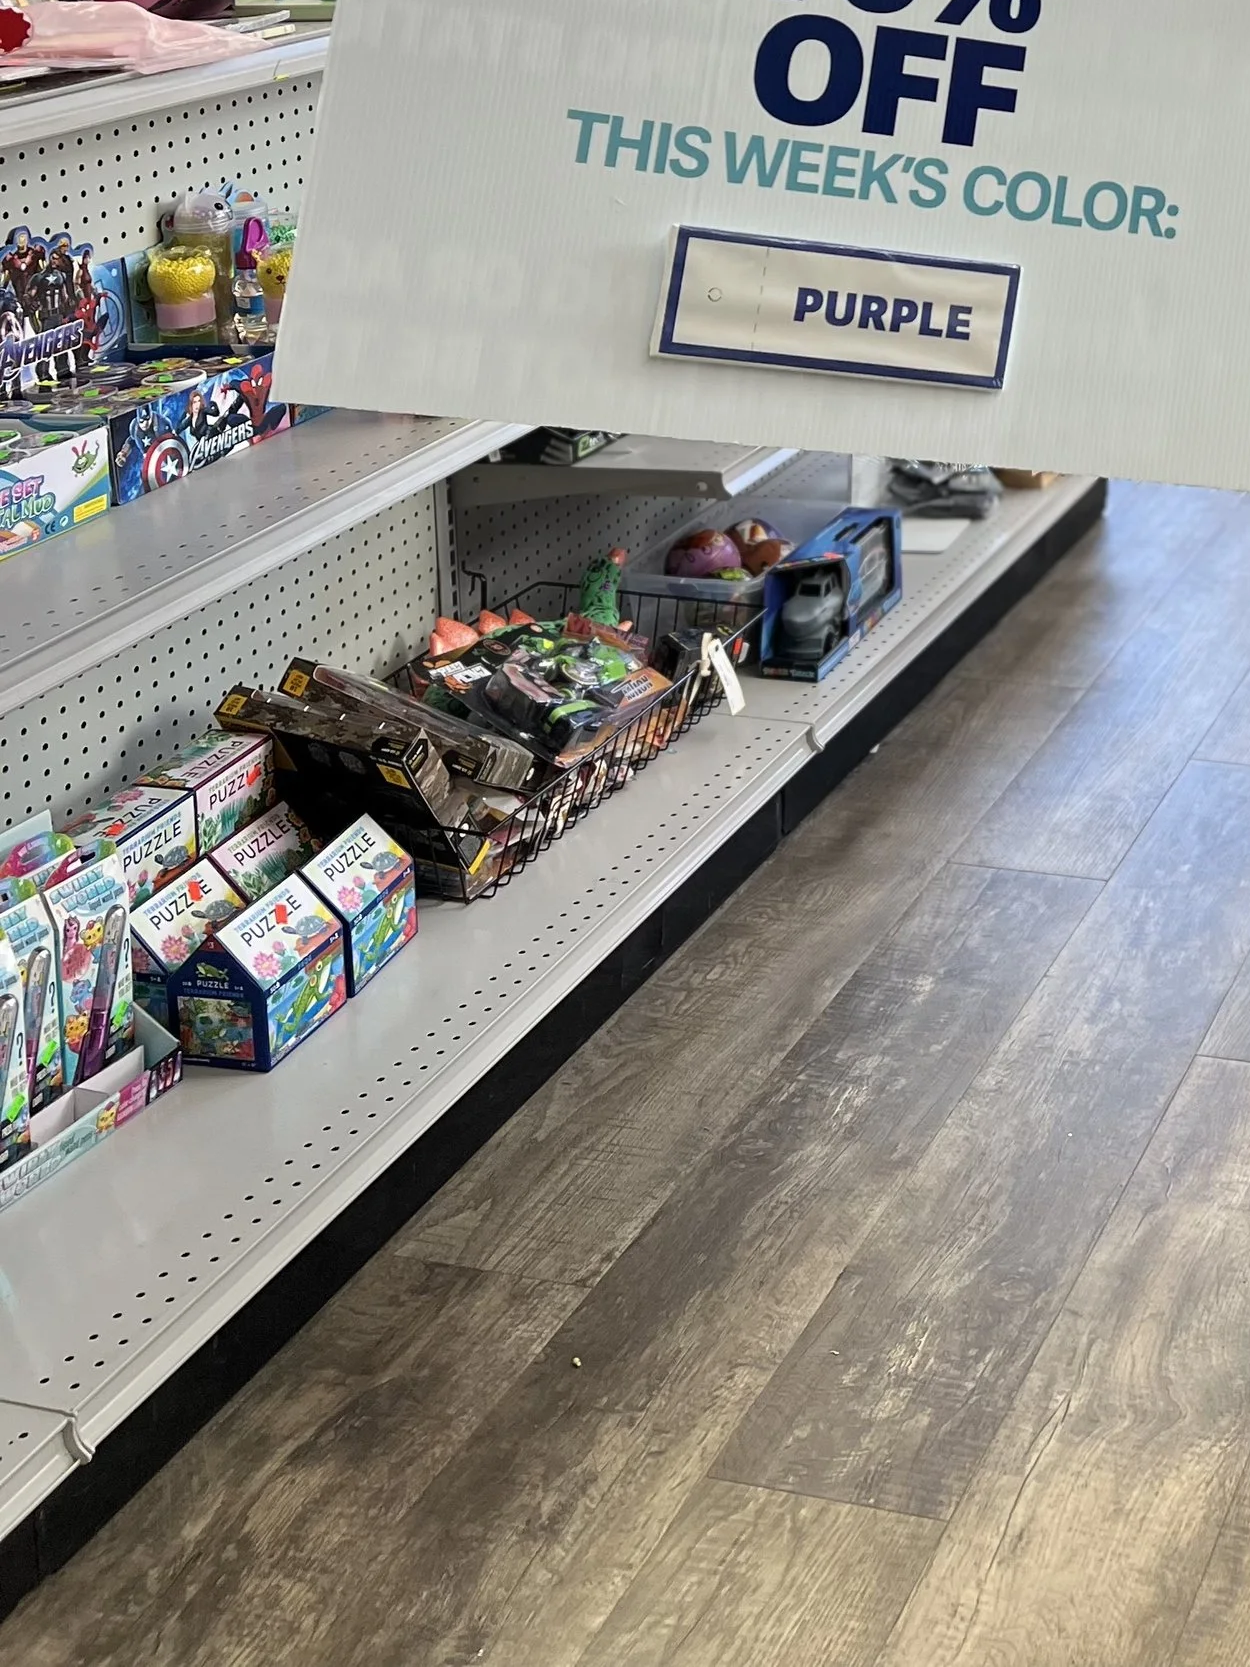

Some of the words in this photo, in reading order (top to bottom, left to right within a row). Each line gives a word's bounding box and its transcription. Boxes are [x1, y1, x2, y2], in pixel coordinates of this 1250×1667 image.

[753, 13, 1028, 147] OFF
[566, 109, 711, 179] THIS
[723, 130, 948, 209] WEEK'S
[961, 164, 1180, 240] COLOR:
[792, 285, 974, 341] PURPLE
[190, 420, 254, 472] AVENGERS
[12, 476, 44, 502] SET
[209, 763, 263, 810] PUZZ
[122, 819, 182, 873] PUZZLE
[233, 819, 291, 866] PUZZLE
[324, 832, 377, 882] PUZZLE
[149, 879, 212, 931] PUZZE
[196, 979, 230, 990] PUZZLE
